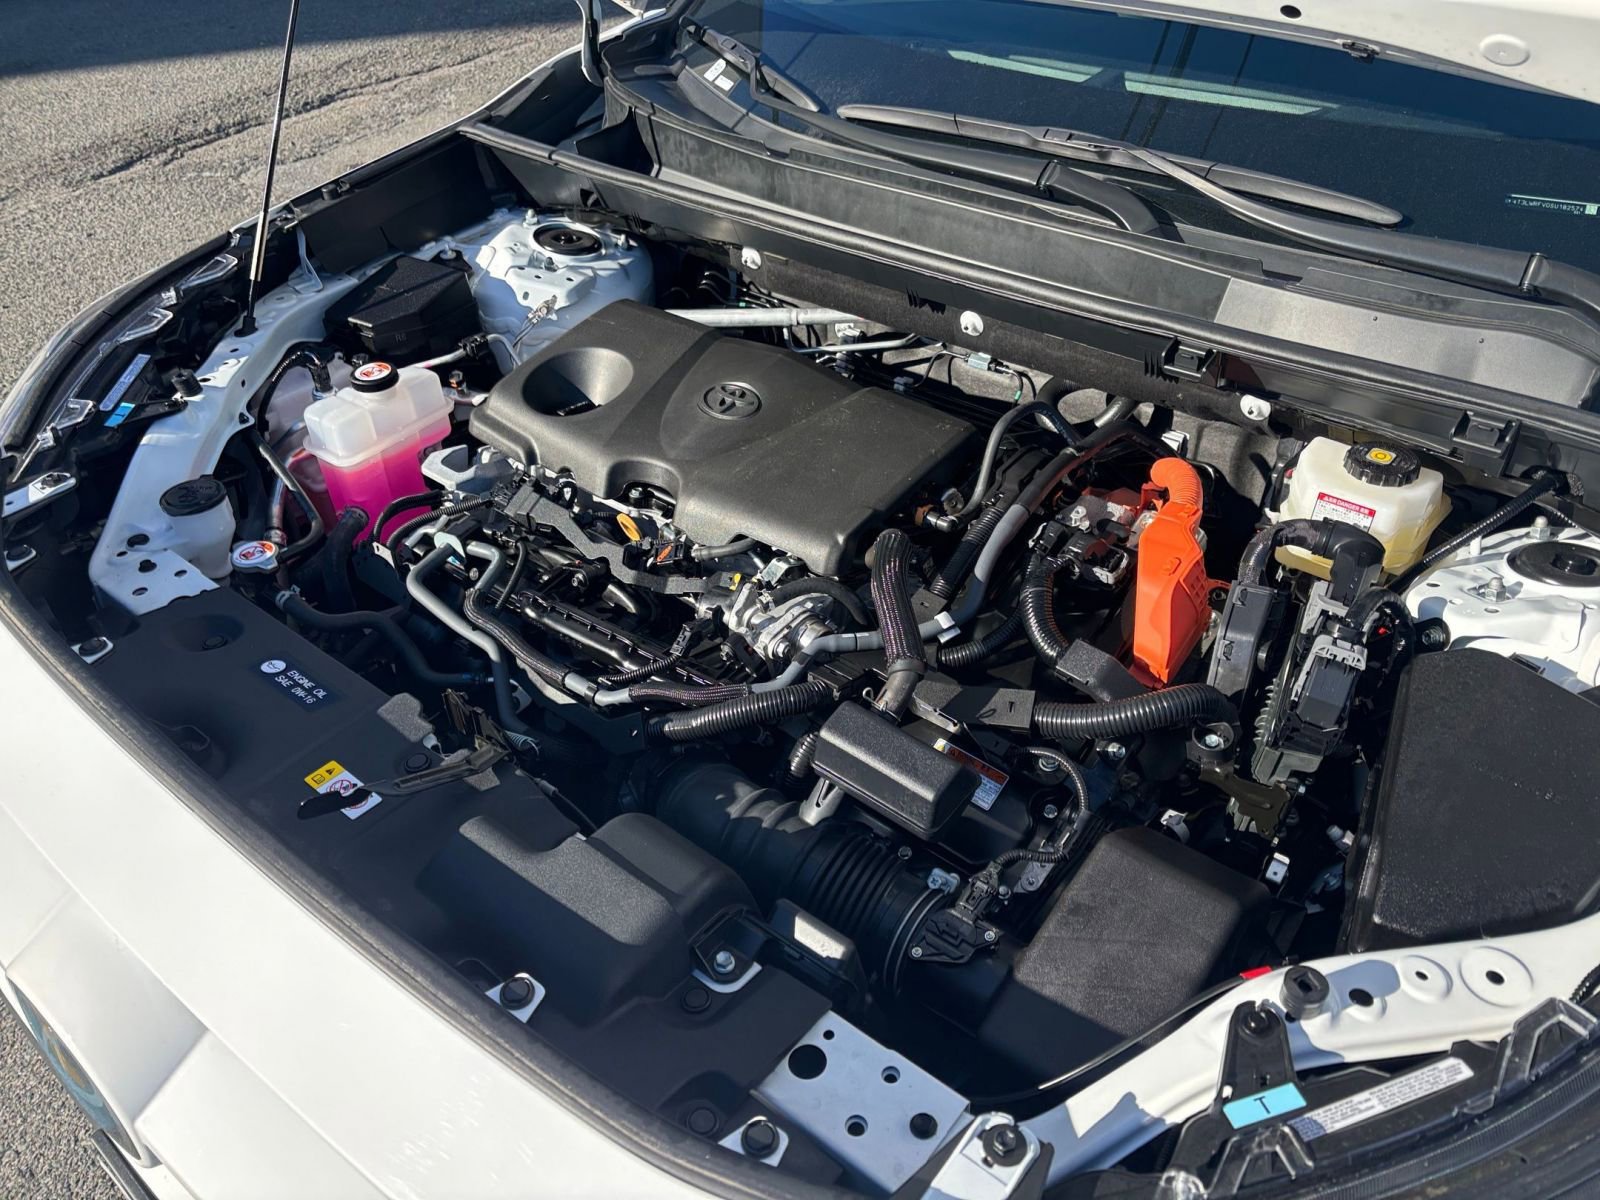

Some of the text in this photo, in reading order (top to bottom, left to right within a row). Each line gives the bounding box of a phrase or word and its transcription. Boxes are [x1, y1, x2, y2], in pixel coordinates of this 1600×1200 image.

[275, 675, 294, 687] SAE
[286, 670, 327, 699] ENGINE OIL
[1253, 1096, 1271, 1115] T
